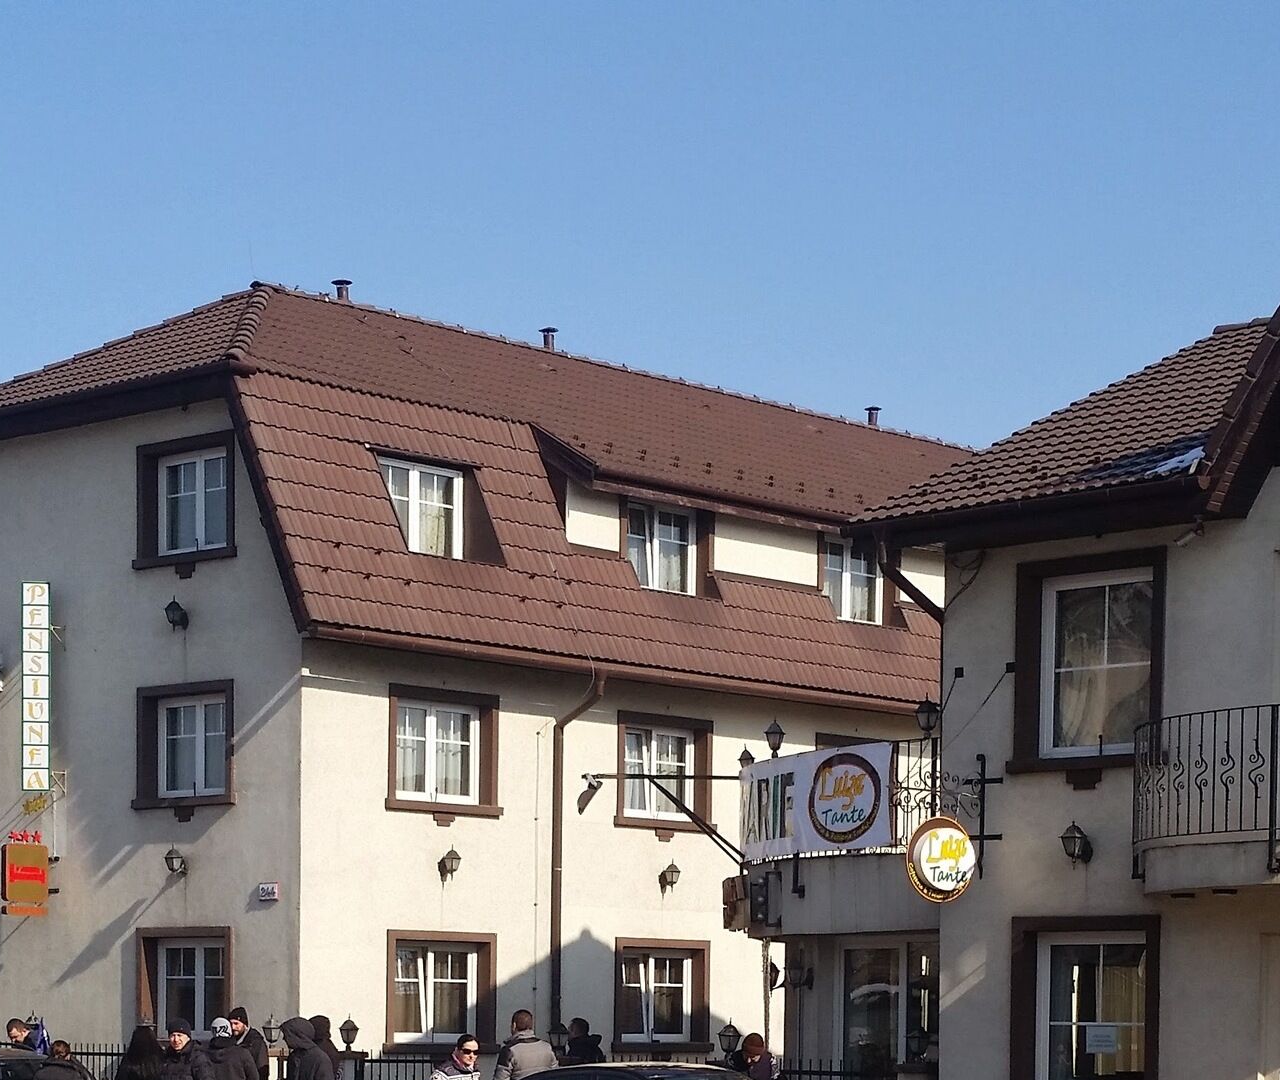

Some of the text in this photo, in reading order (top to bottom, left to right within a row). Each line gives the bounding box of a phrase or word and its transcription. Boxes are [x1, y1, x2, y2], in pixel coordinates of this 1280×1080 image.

[25, 583, 48, 789] PENSIUNEA
[822, 805, 867, 828] Tante
[930, 865, 969, 884] Tante
